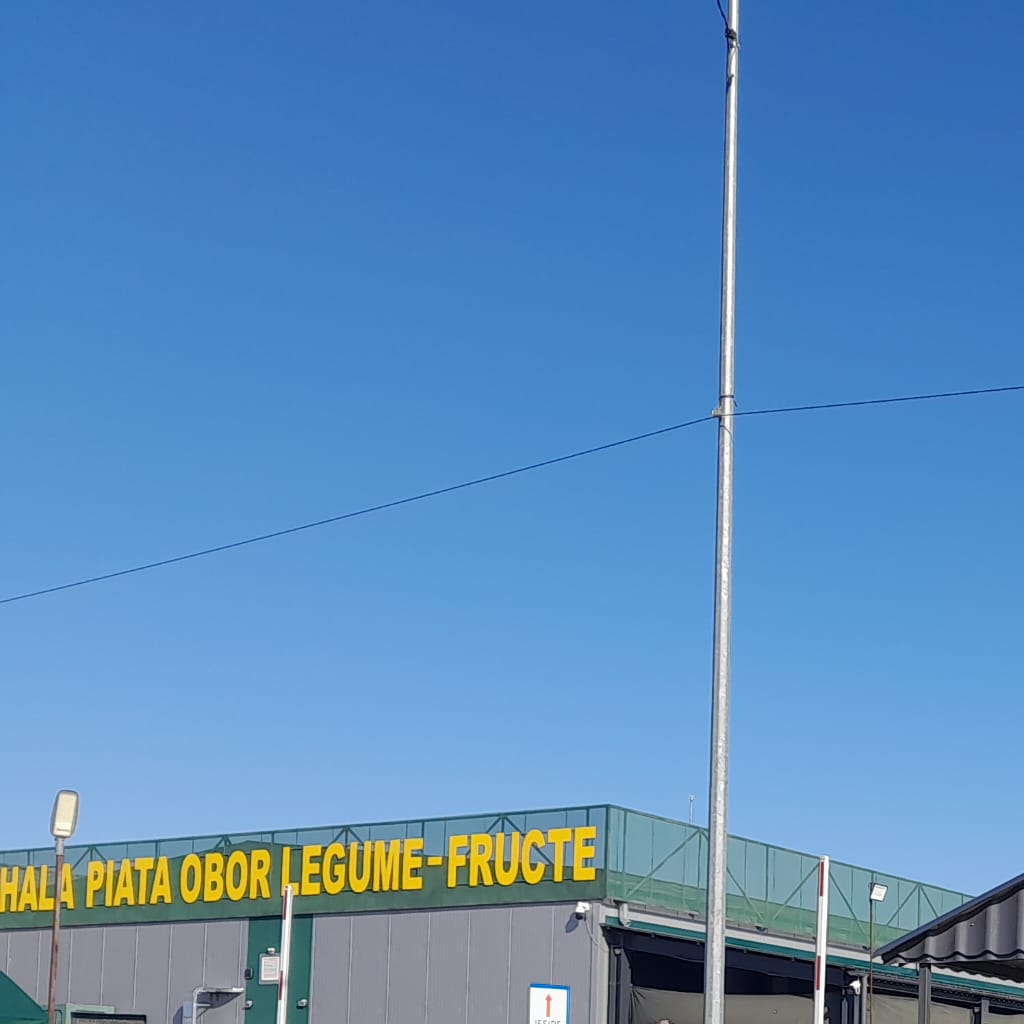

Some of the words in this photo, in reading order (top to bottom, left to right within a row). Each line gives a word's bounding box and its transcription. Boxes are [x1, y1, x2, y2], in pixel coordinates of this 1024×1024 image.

[0, 863, 75, 913] HALA
[86, 856, 172, 908] PIATA
[180, 849, 271, 904] OBOR
